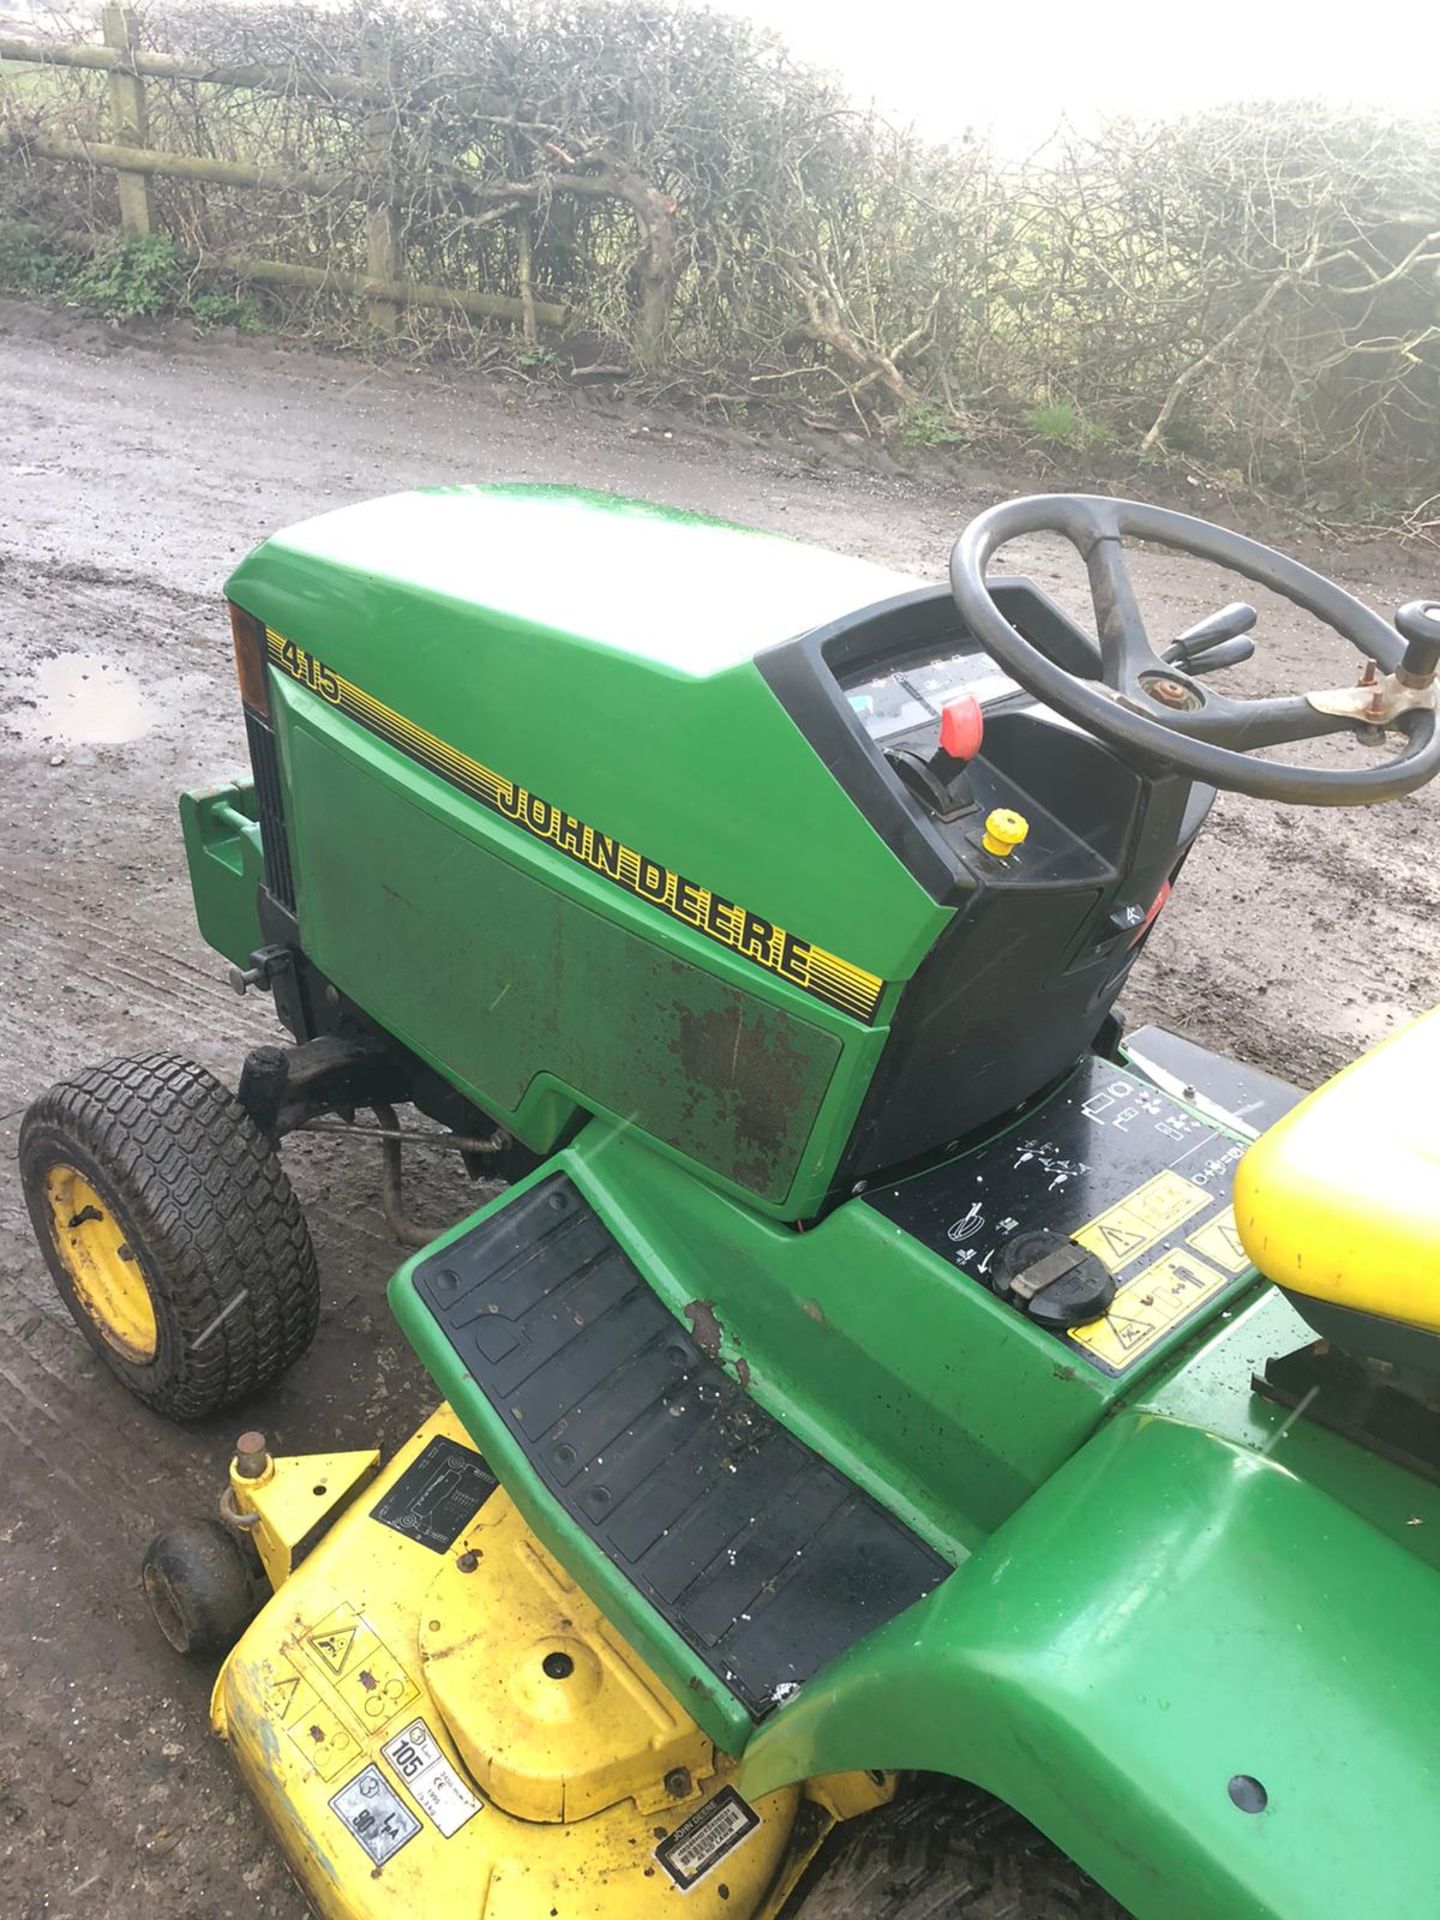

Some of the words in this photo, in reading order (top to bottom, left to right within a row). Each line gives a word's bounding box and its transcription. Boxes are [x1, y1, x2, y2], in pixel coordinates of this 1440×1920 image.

[281, 638, 341, 704] 415
[497, 783, 622, 880] JOHN
[635, 854, 813, 988] DEERE
[391, 1739, 424, 1777] 105
[674, 1821, 694, 1841] JOHN
